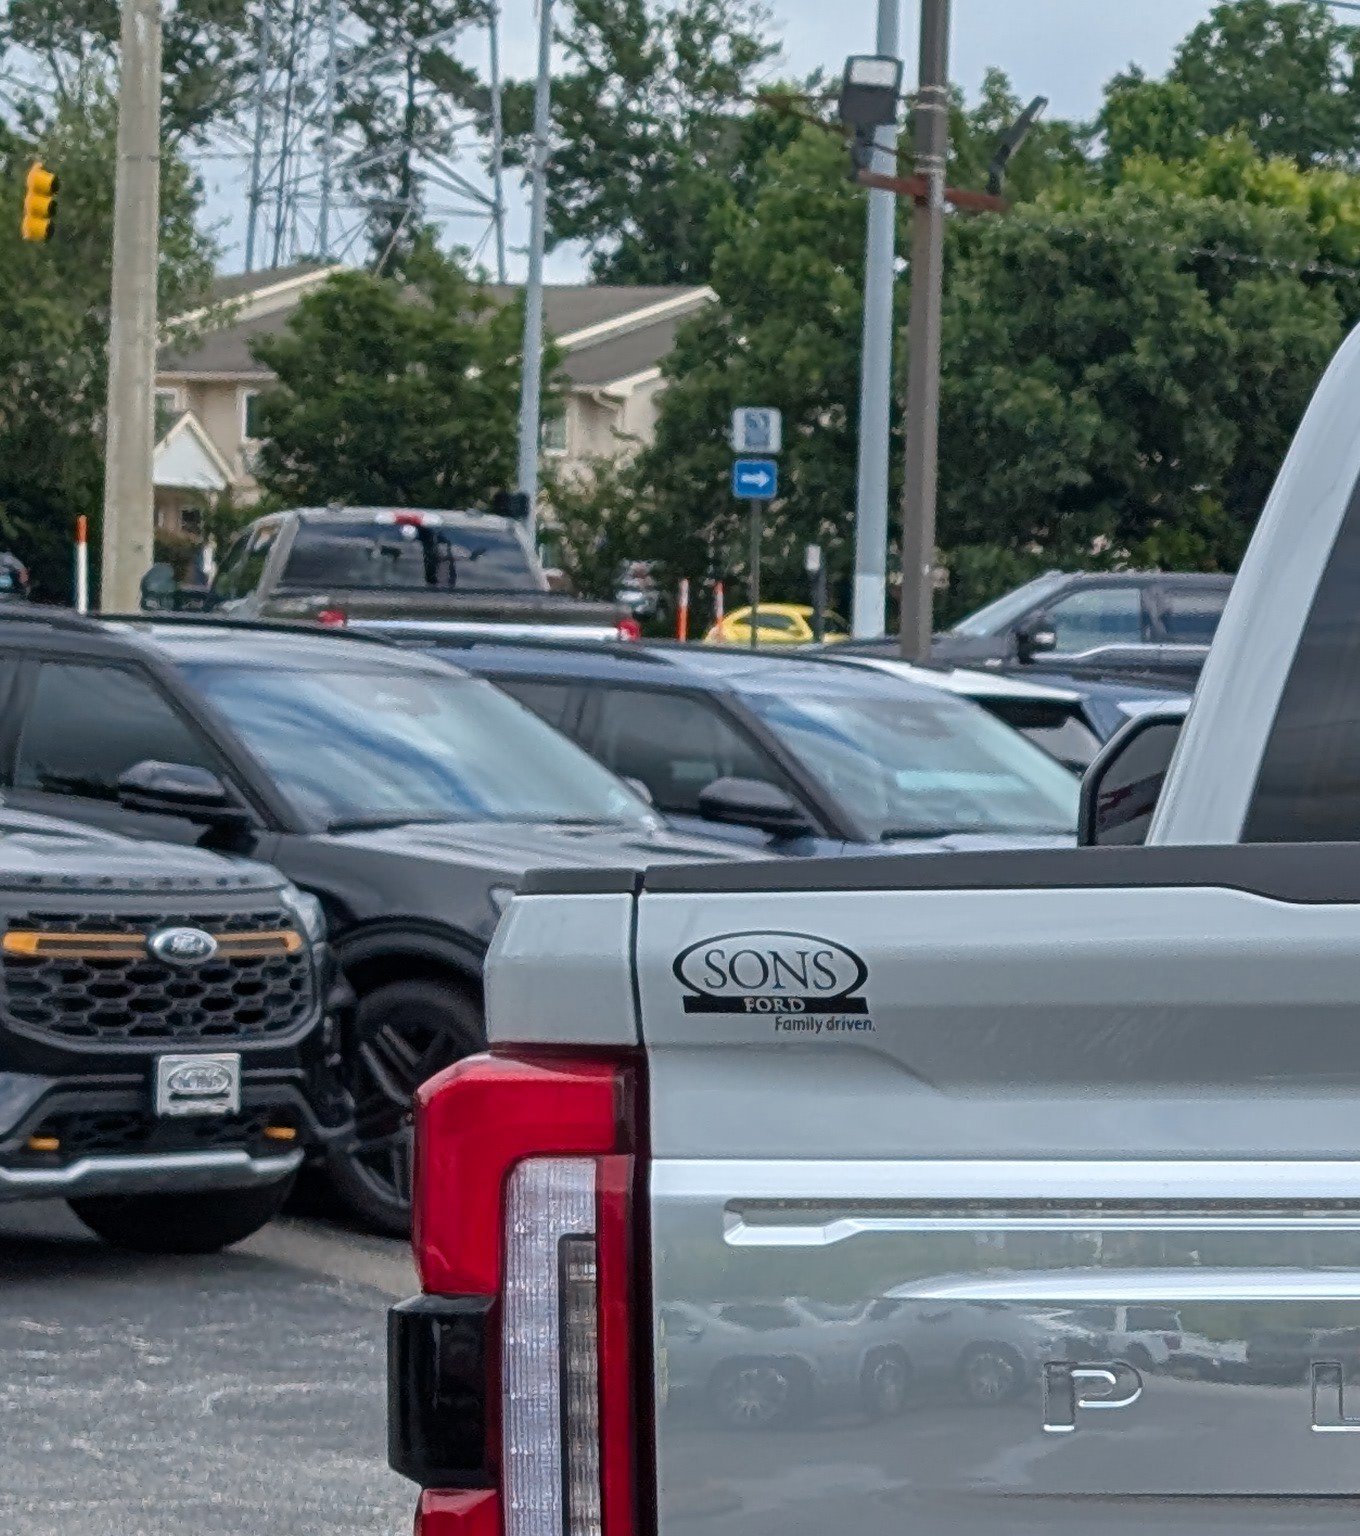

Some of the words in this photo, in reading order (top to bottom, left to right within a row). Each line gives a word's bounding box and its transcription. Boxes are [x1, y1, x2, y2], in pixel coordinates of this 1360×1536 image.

[703, 949, 838, 990] SONS
[743, 997, 806, 1013] FORD
[774, 1016, 823, 1034] Family
